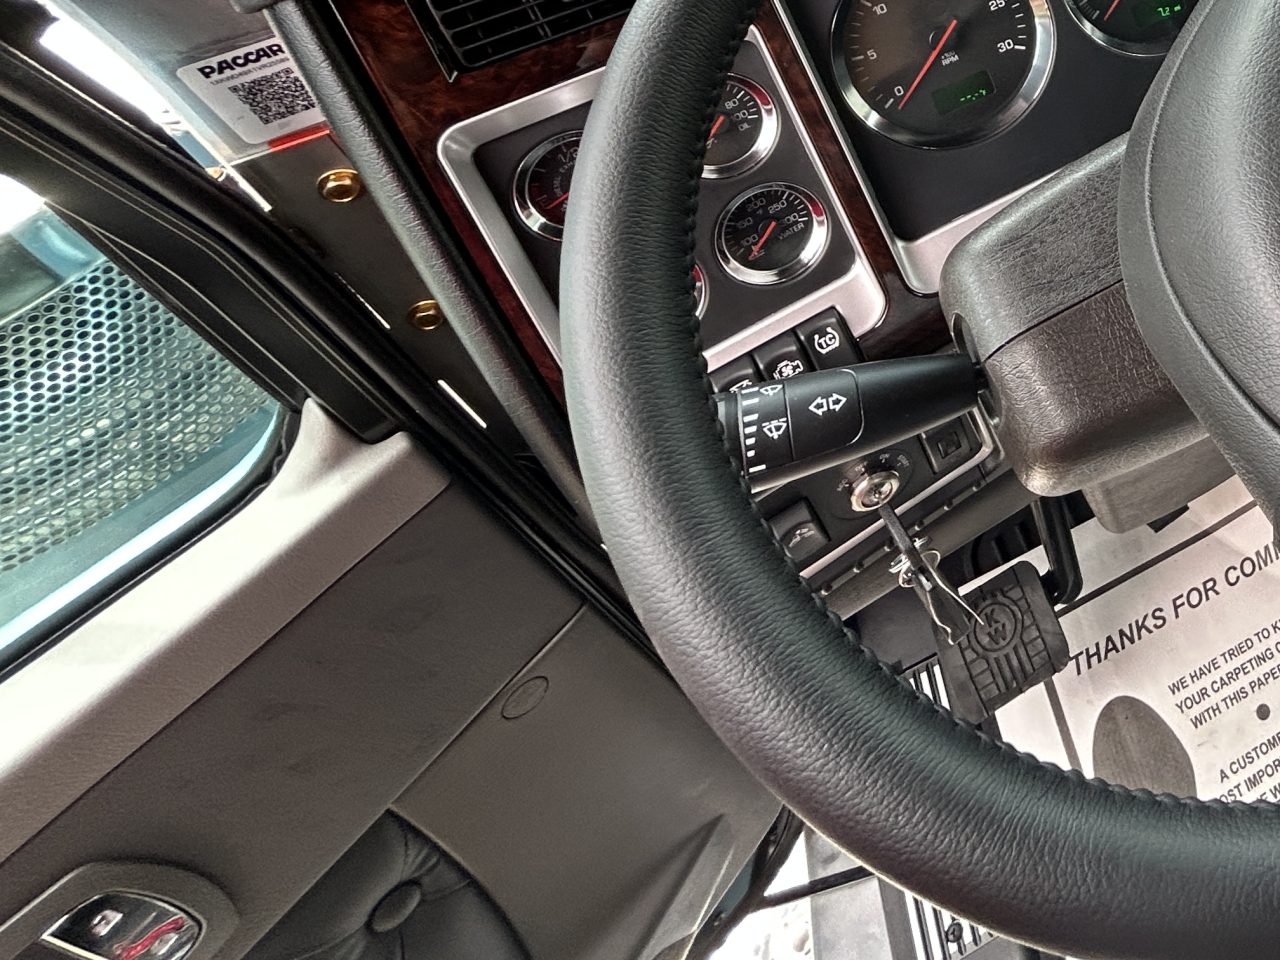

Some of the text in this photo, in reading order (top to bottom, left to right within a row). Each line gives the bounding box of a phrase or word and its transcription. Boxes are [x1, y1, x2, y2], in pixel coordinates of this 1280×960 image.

[872, 3, 888, 15] 10
[997, 38, 1014, 52] 30
[197, 43, 285, 79] PACCAR
[867, 49, 877, 60] 5
[941, 54, 960, 66] RPM
[893, 86, 904, 97] 0
[725, 98, 739, 111] 80
[768, 199, 787, 214] 250
[777, 222, 805, 240] WATER
[819, 334, 835, 348] TC
[1070, 606, 1168, 676] THANKS
[1172, 577, 1220, 620] FOR
[1167, 675, 1189, 696] WE
[1190, 659, 1220, 688] HAVE
[1220, 639, 1253, 669] TRIED
[1253, 627, 1271, 648] TO
[1176, 685, 1211, 714] YOUR
[1210, 647, 1275, 695] CARPETING
[1190, 704, 1222, 730] WITH
[1221, 687, 1249, 712] THIS
[1220, 769, 1229, 783] A
